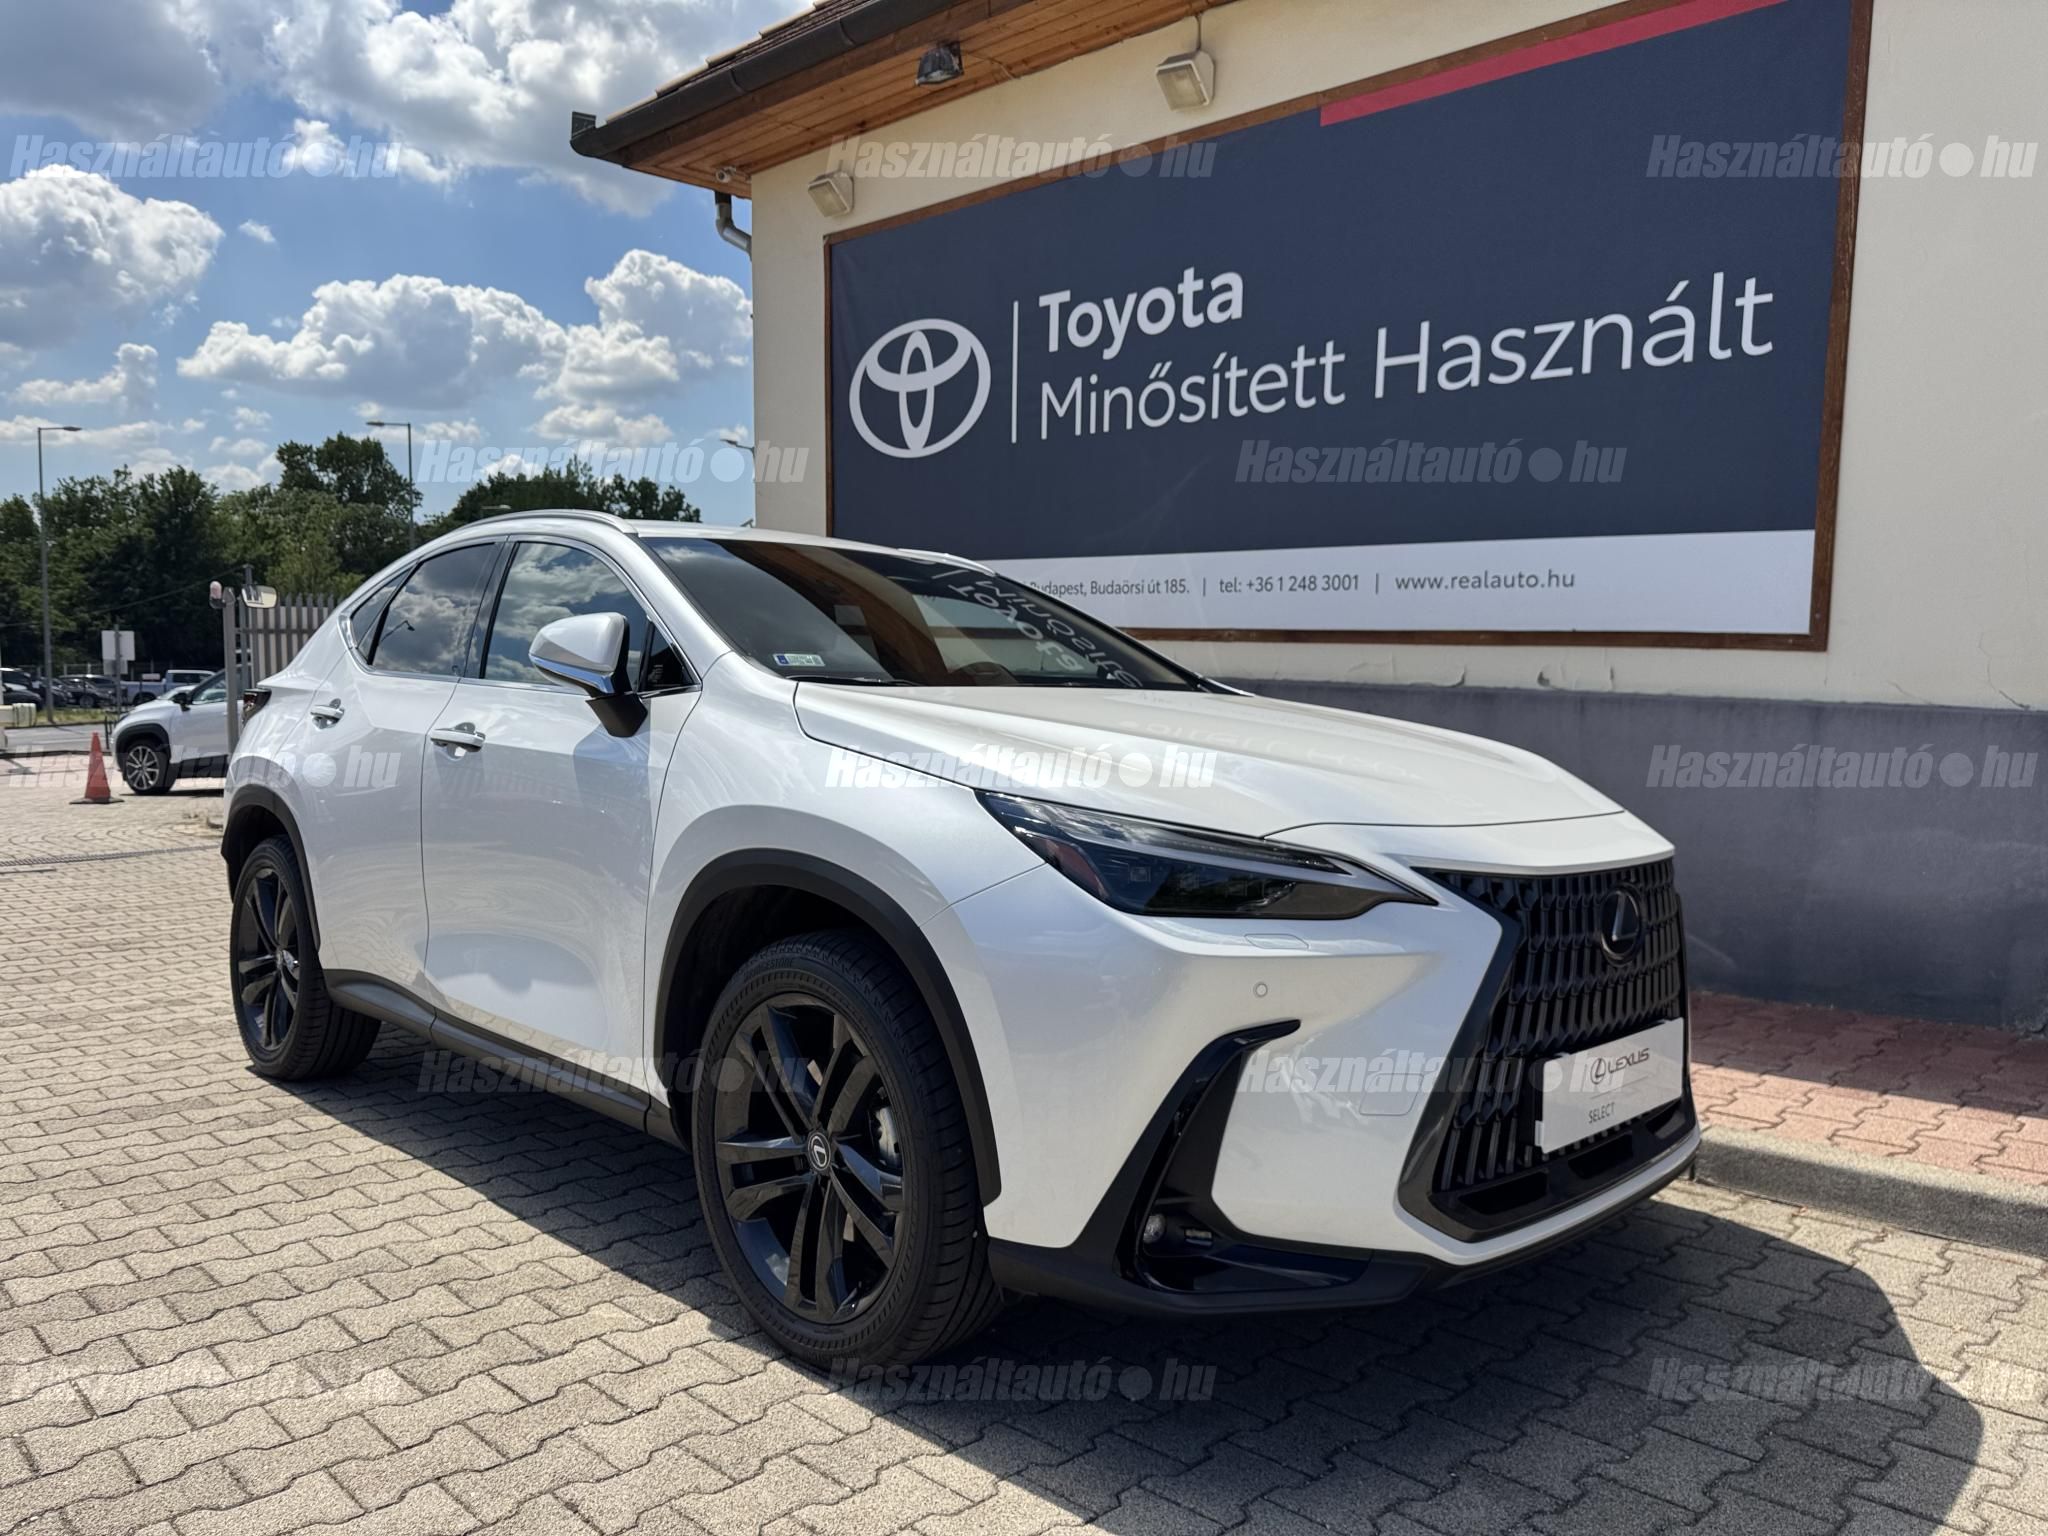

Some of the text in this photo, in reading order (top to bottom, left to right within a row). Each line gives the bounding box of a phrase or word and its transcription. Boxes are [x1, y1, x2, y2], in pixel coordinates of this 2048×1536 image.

[1039, 266, 1244, 360] Toyota
[1041, 271, 1774, 440] Minősített Használt
[1090, 579, 1145, 595] Budaörsi
[1147, 579, 1161, 594] út
[1164, 578, 1190, 594] 185.
[1219, 576, 1242, 593] tel:
[1321, 574, 1359, 591] 3001
[1395, 569, 1575, 589] www.realauto.hu
[1608, 1048, 1649, 1074] LEXUS
[1588, 1101, 1615, 1124] SELECT
